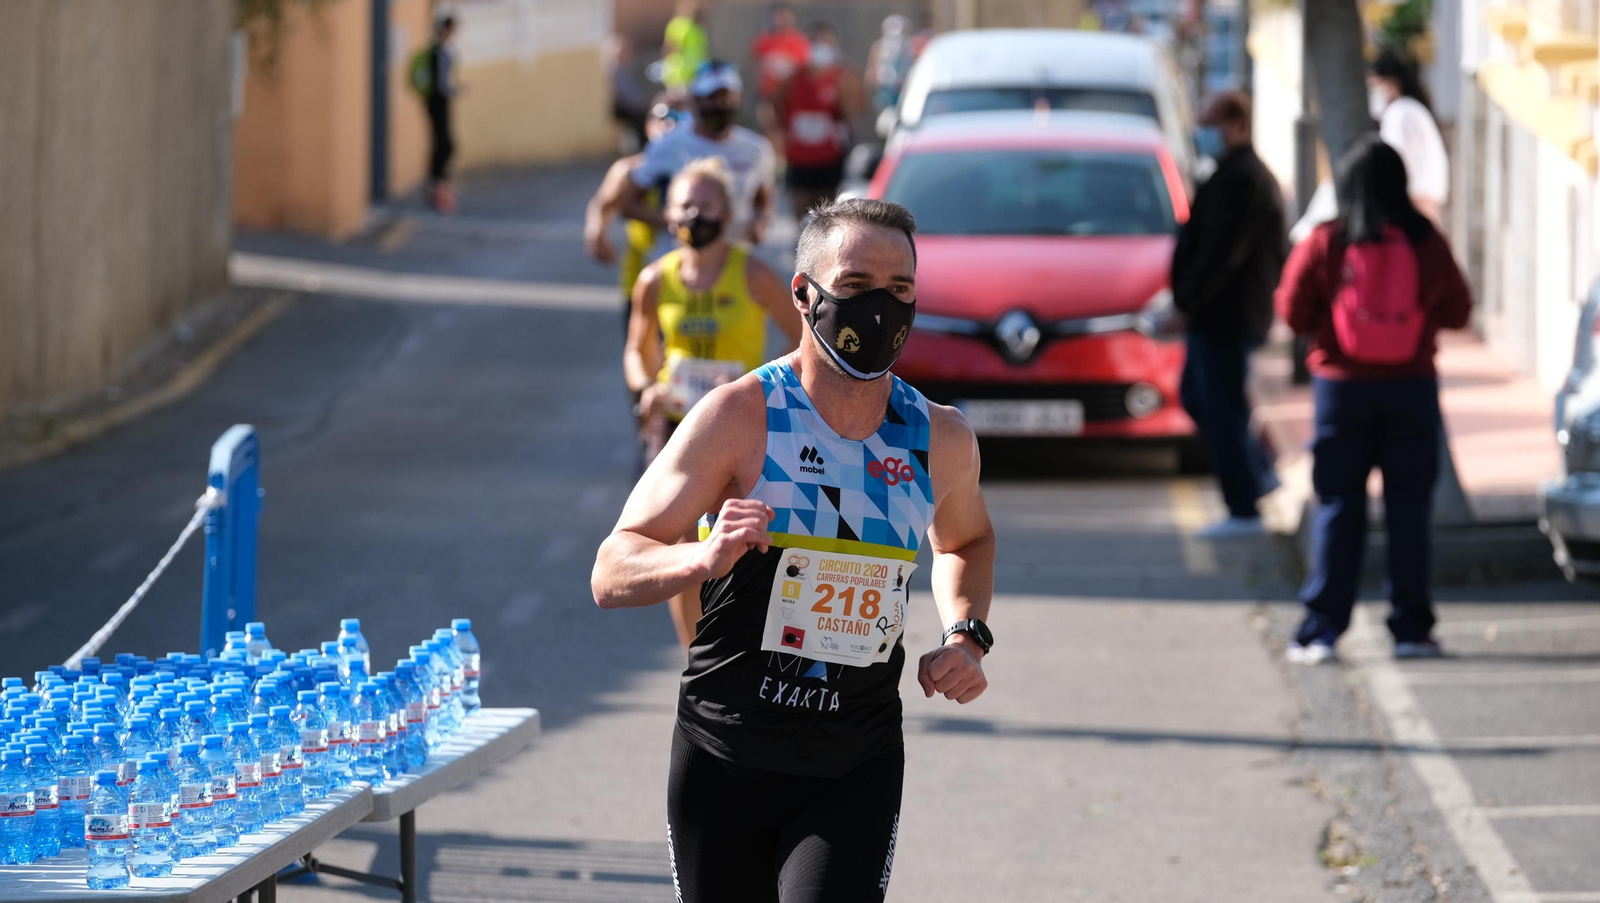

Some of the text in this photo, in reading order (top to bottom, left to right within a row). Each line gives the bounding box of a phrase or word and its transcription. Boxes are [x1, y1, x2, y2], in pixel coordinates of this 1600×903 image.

[800, 465, 825, 475] mobel
[867, 457, 915, 486] ego
[816, 572, 849, 584] CARRERAS
[850, 576, 887, 589] POPULARES
[818, 558, 862, 575] CIRCUITO
[863, 563, 888, 579] 2020
[810, 583, 882, 620] 218
[817, 616, 871, 637] CASTAÑO
[890, 601, 900, 633] RIOJA
[758, 675, 840, 712] EXAKTA
